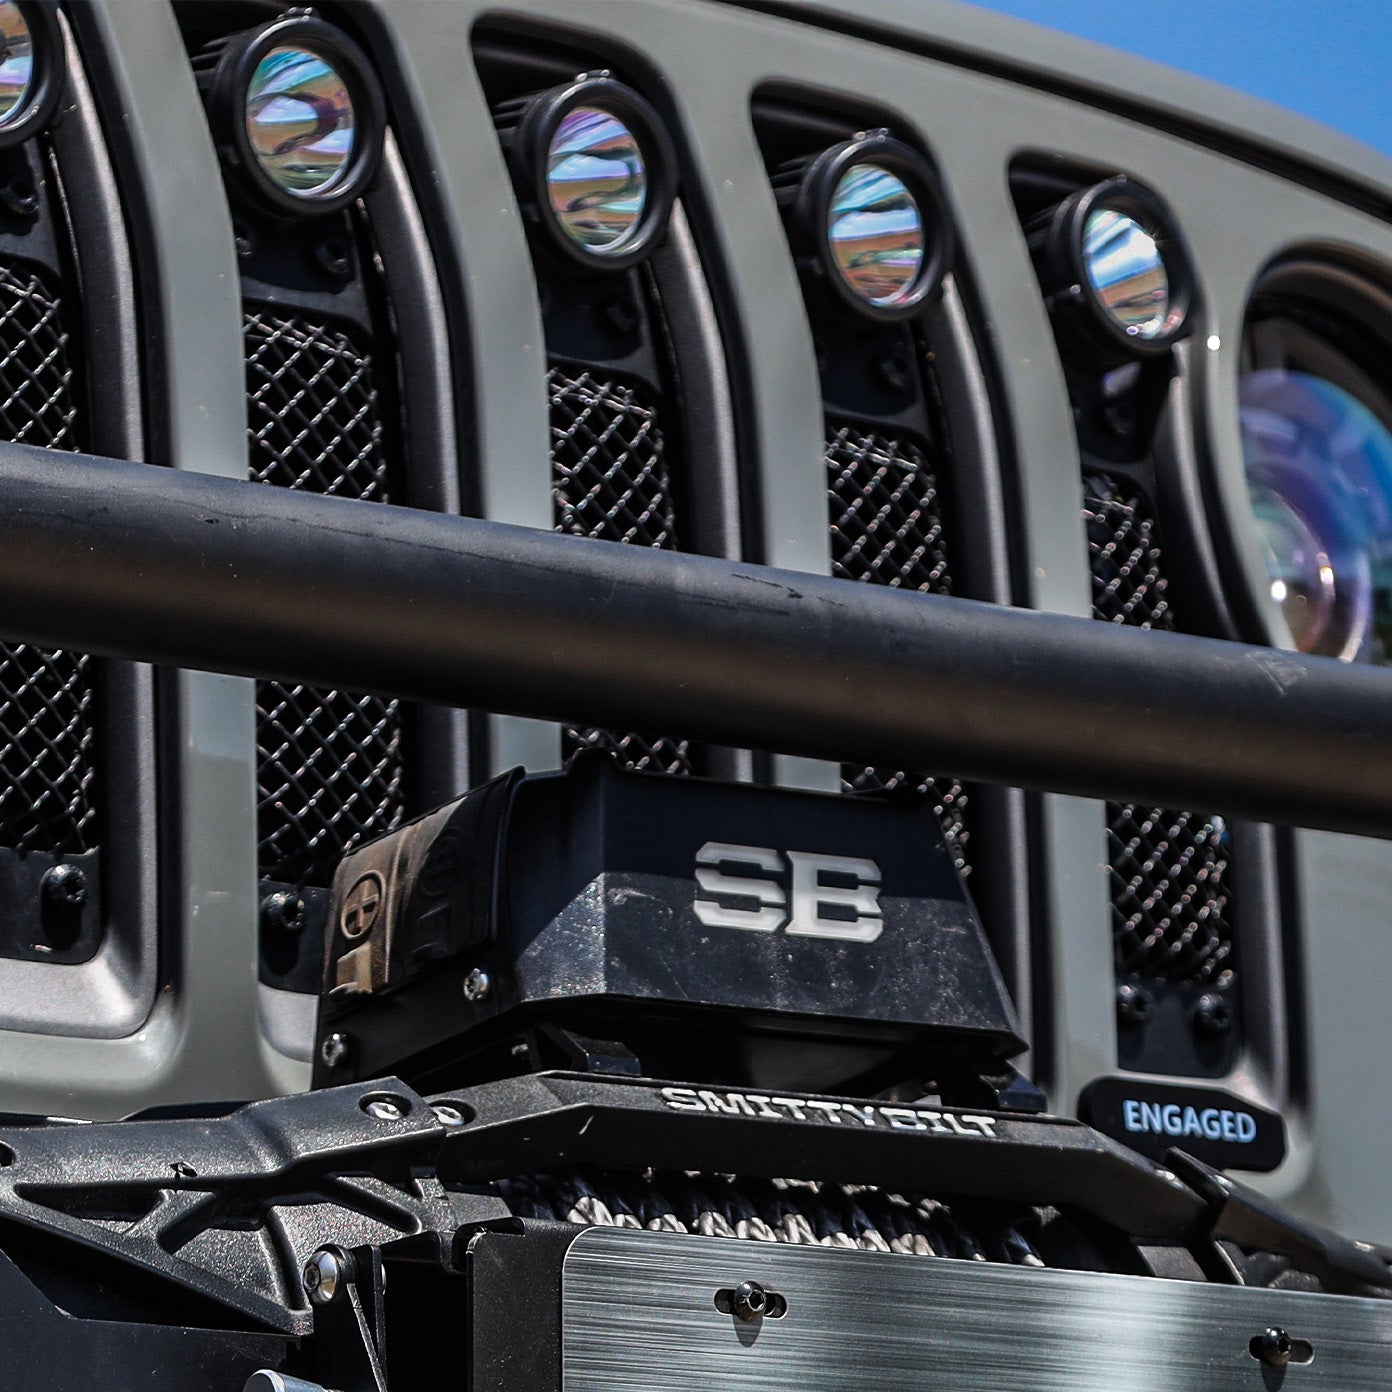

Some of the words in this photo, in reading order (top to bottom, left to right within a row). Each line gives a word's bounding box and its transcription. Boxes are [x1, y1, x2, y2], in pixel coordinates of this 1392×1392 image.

[693, 841, 884, 944] SB
[661, 1086, 997, 1138] SMITTYBILT
[1122, 1099, 1258, 1144] ENGAGED
